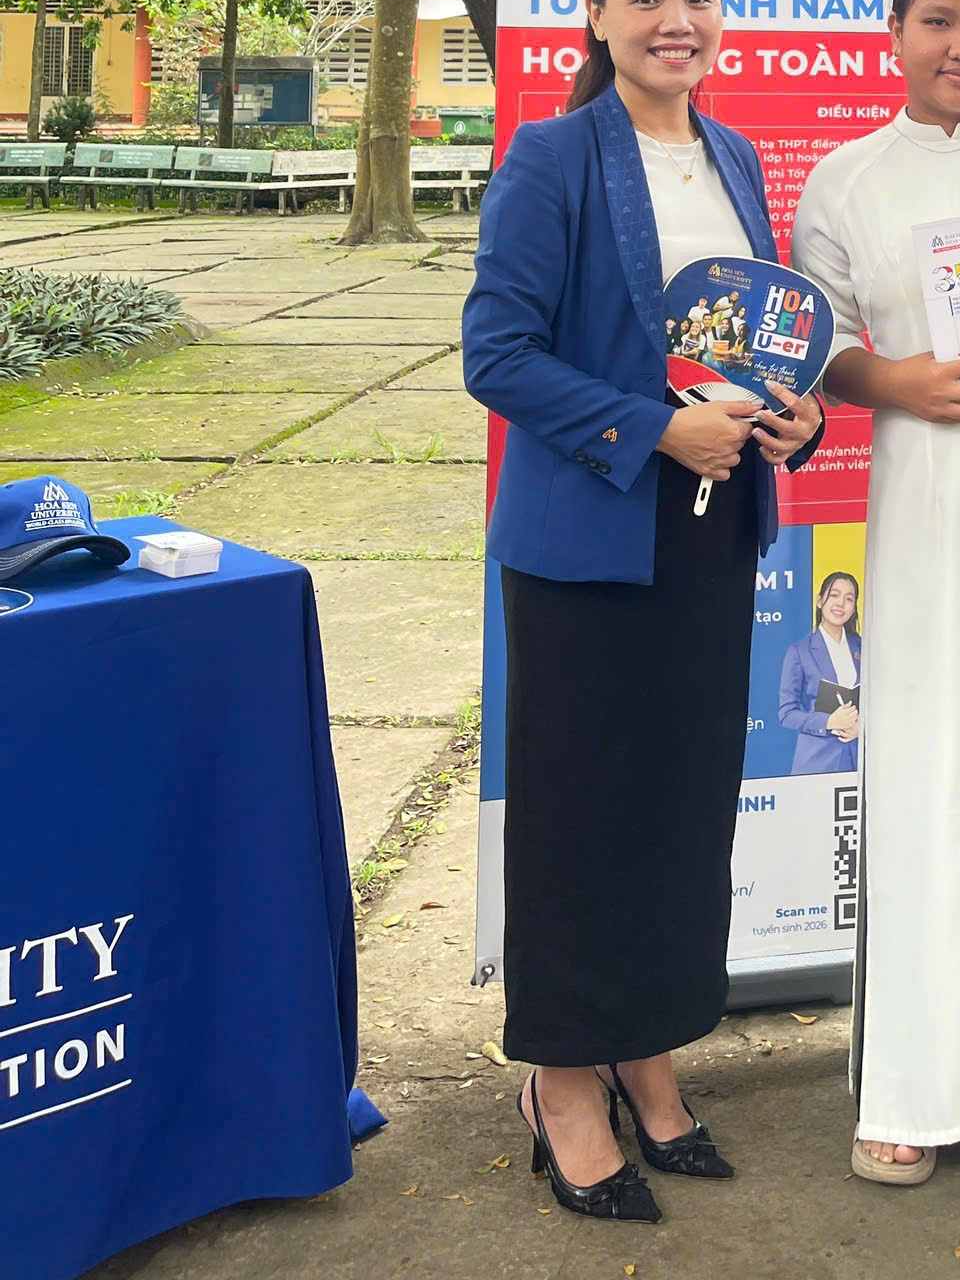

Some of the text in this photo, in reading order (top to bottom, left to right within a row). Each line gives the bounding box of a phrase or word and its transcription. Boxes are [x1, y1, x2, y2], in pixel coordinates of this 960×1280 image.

[522, 46, 587, 81] HỌ
[756, 43, 864, 77] TOÀN
[856, 106, 890, 121] KIỆN
[759, 138, 775, 151] bạ
[777, 139, 809, 150] THPT
[763, 152, 794, 165] lớp 11
[768, 168, 806, 179] thi Tốt
[775, 183, 782, 192] 3
[785, 182, 804, 192] mô
[768, 198, 785, 208] thi
[764, 285, 815, 315] HOA
[760, 311, 815, 340] SEN
[757, 332, 806, 355] U-er
[819, 461, 845, 472] sinh
[34, 501, 61, 512] HOA
[31, 510, 81, 520] UNIVERSITY
[783, 570, 794, 590] 1
[755, 609, 782, 625] tạo
[736, 795, 776, 813] INH
[775, 905, 828, 919] Scan me
[782, 921, 802, 934] sinh
[804, 920, 828, 933] 2026
